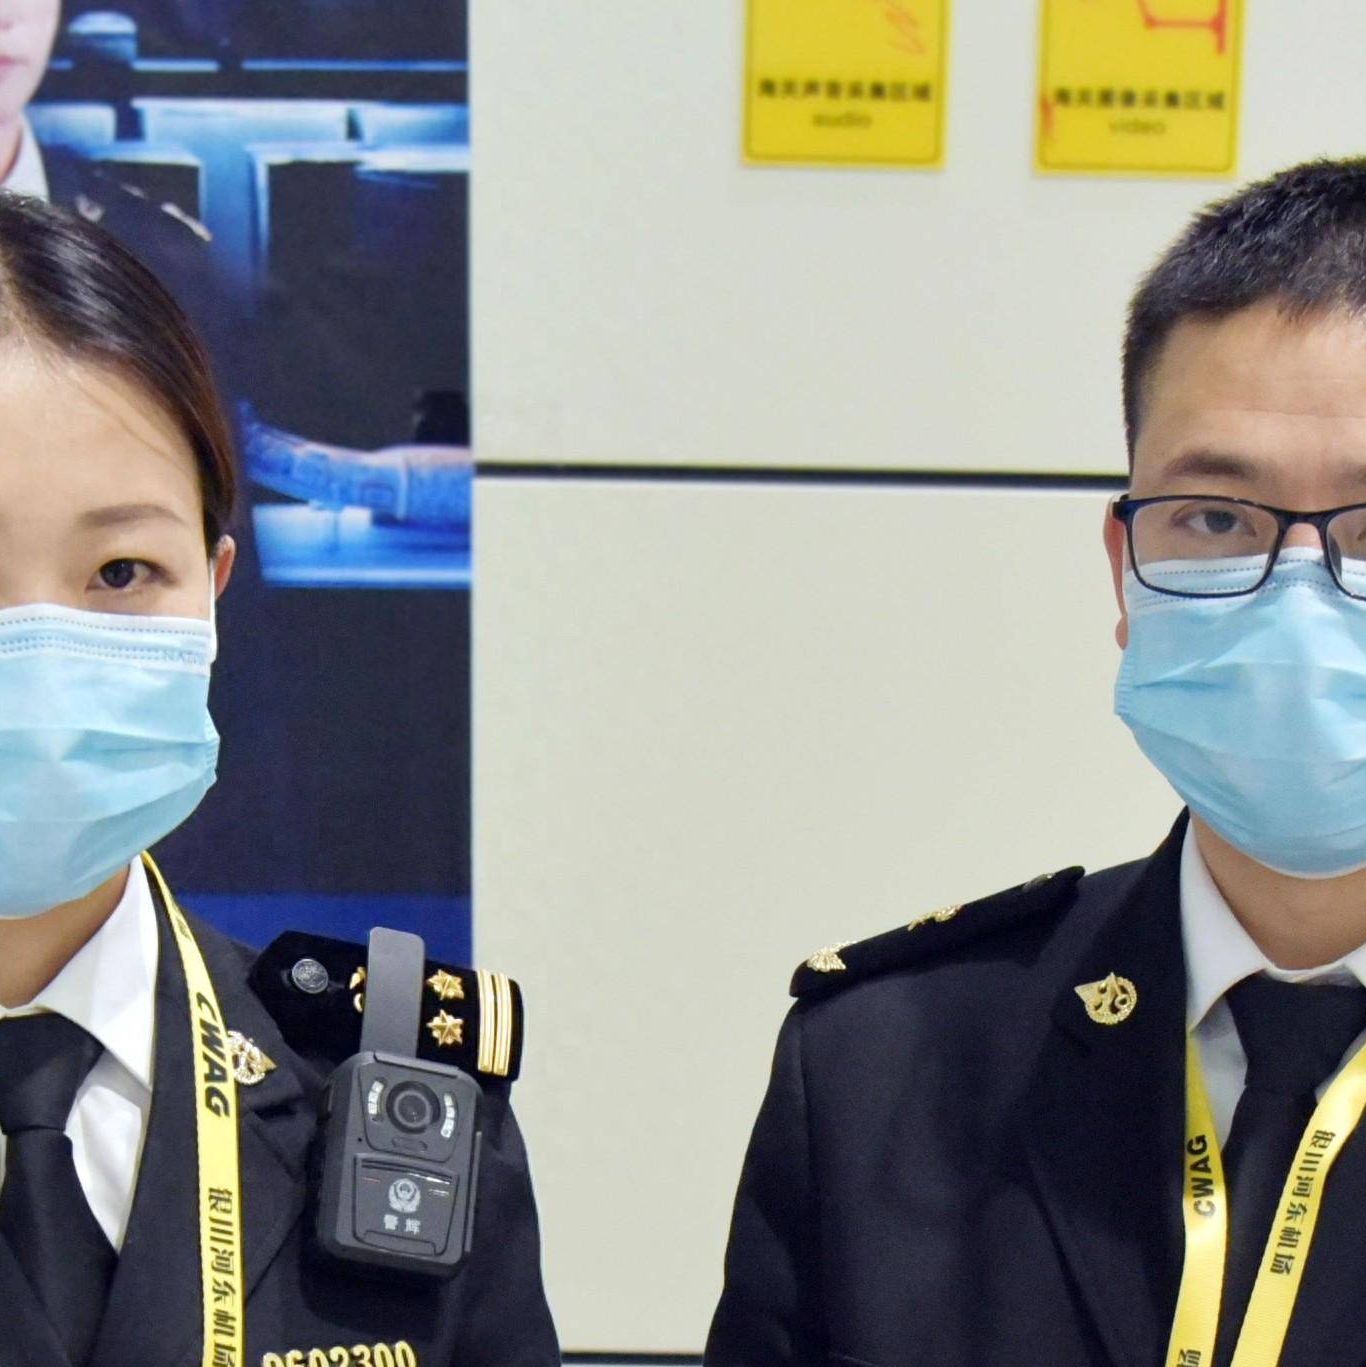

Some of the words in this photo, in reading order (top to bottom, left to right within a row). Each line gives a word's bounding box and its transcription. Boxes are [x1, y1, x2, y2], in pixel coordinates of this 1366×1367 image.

[196, 991, 230, 1118] CWAG
[1186, 1134, 1216, 1218] CWAG
[1269, 1129, 1337, 1276] 银川河东机场
